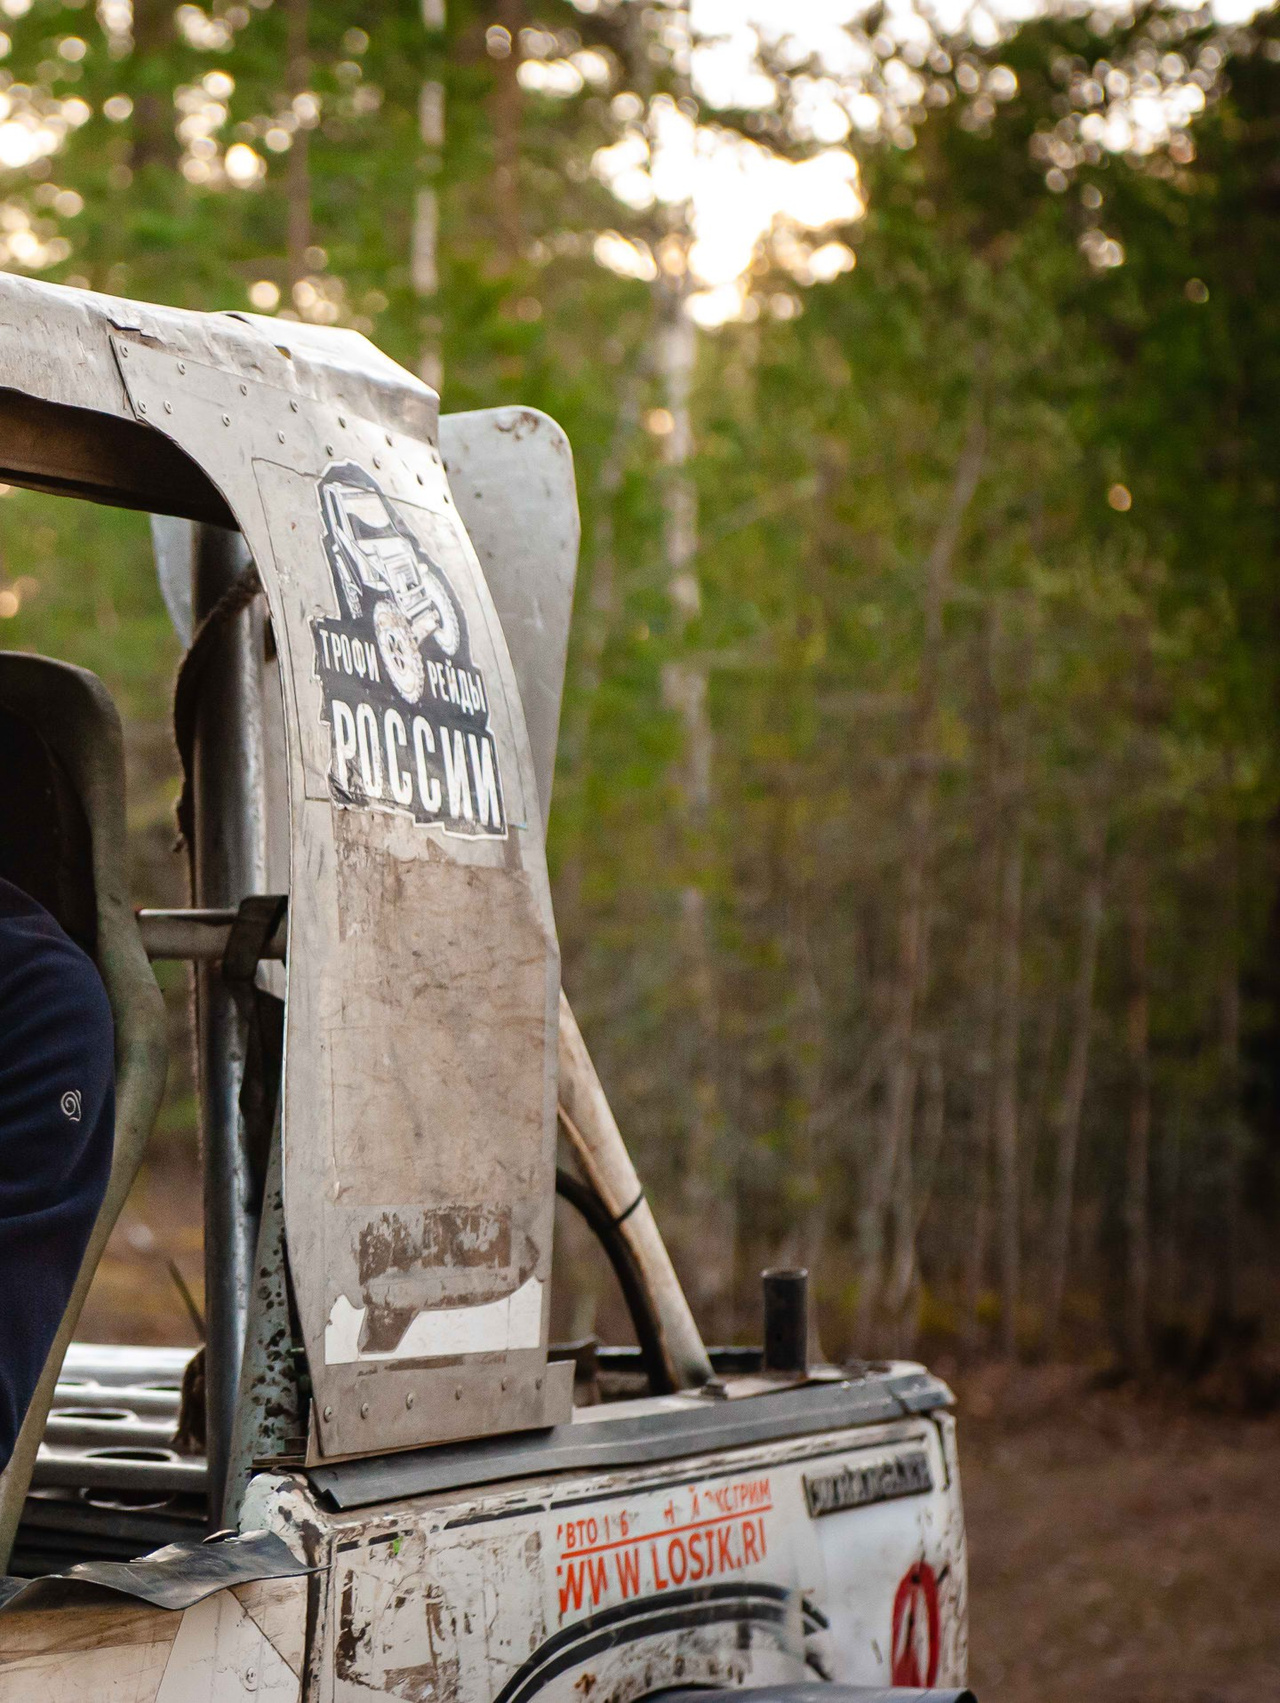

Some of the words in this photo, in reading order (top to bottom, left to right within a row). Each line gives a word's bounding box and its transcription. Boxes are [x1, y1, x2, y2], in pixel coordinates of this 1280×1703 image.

[320, 629, 381, 683] ТРОФИ
[426, 659, 487, 716] РЕЙДЫ
[332, 699, 502, 829] РОССИИ
